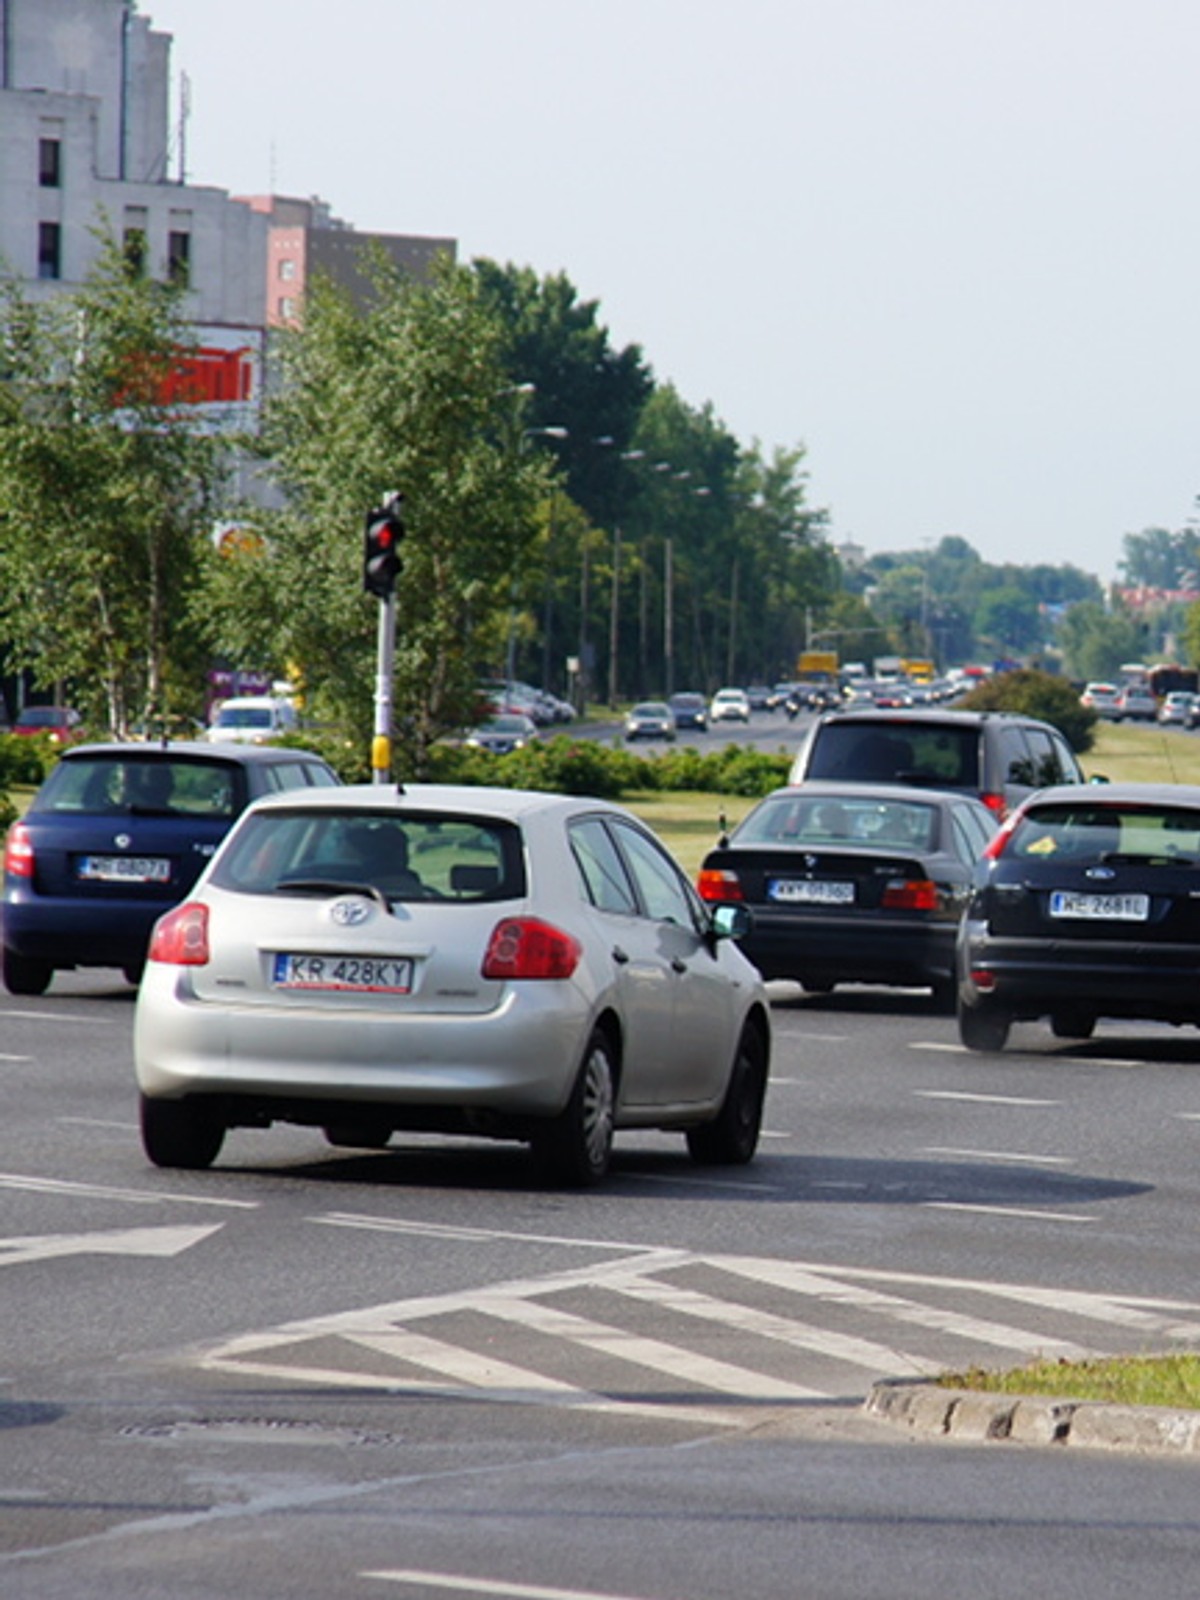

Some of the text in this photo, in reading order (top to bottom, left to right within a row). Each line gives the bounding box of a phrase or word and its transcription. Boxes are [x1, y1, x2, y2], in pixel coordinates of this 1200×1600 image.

[1063, 895, 1144, 916] WE 2681L
[291, 956, 406, 986] KR 428KY
